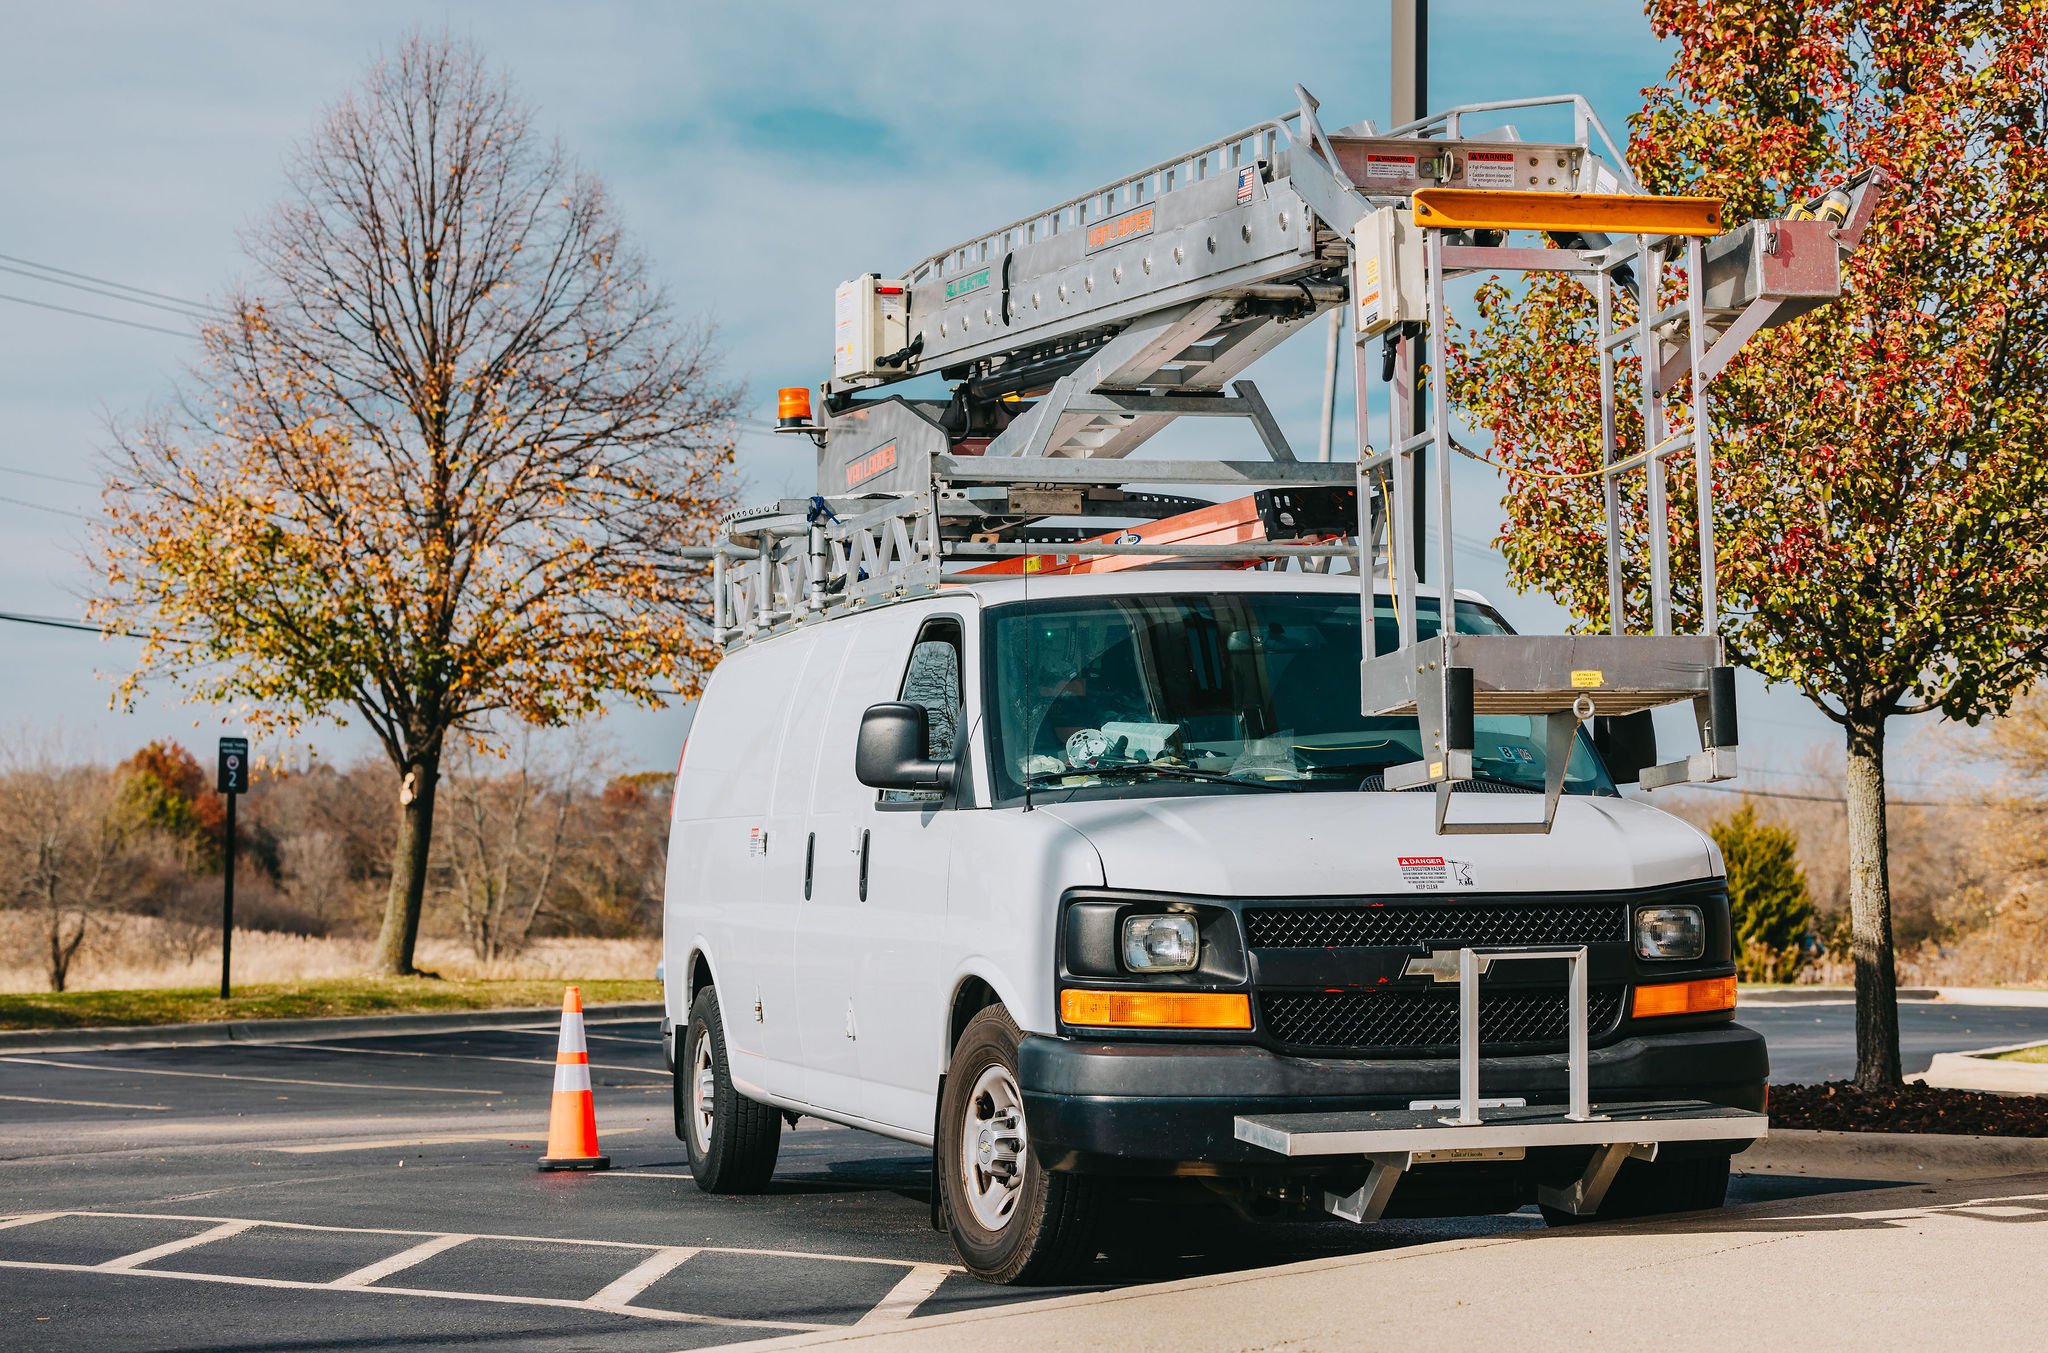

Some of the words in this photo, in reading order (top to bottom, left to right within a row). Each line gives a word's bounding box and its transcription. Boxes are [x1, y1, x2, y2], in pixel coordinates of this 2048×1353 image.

[1478, 153, 1512, 161] WARNING
[1110, 208, 1154, 241] LADDER
[863, 444, 896, 479] LADDER
[1501, 747, 1512, 758] 8
[228, 771, 237, 787] 2
